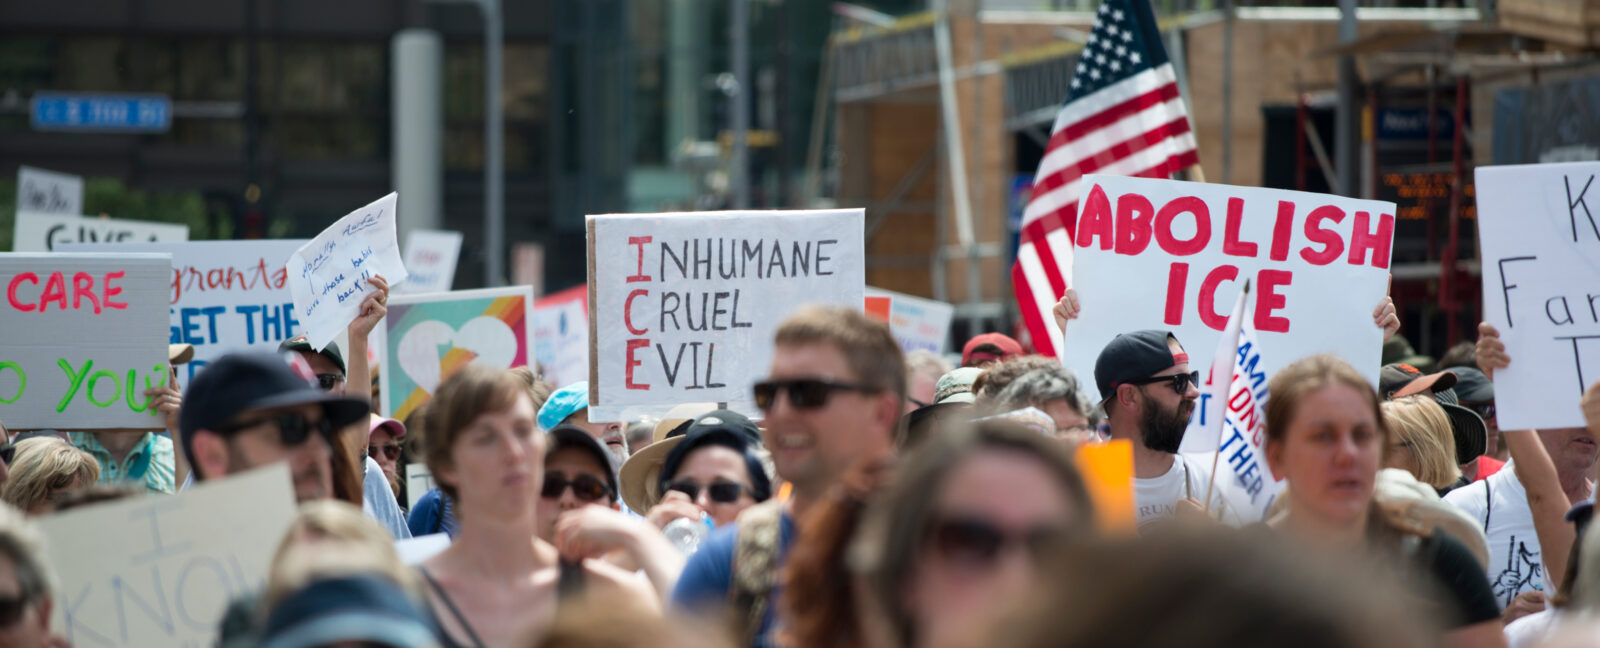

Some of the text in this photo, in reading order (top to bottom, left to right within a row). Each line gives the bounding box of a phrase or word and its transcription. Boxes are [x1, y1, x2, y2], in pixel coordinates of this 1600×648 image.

[1077, 183, 1394, 269] ABOLISH
[627, 235, 838, 283] INHUMANE
[7, 269, 128, 315] CARE
[624, 287, 753, 336] CRUEL
[1163, 261, 1293, 334] ICE
[624, 338, 727, 391] EVIL
[60, 552, 268, 648] KNO
